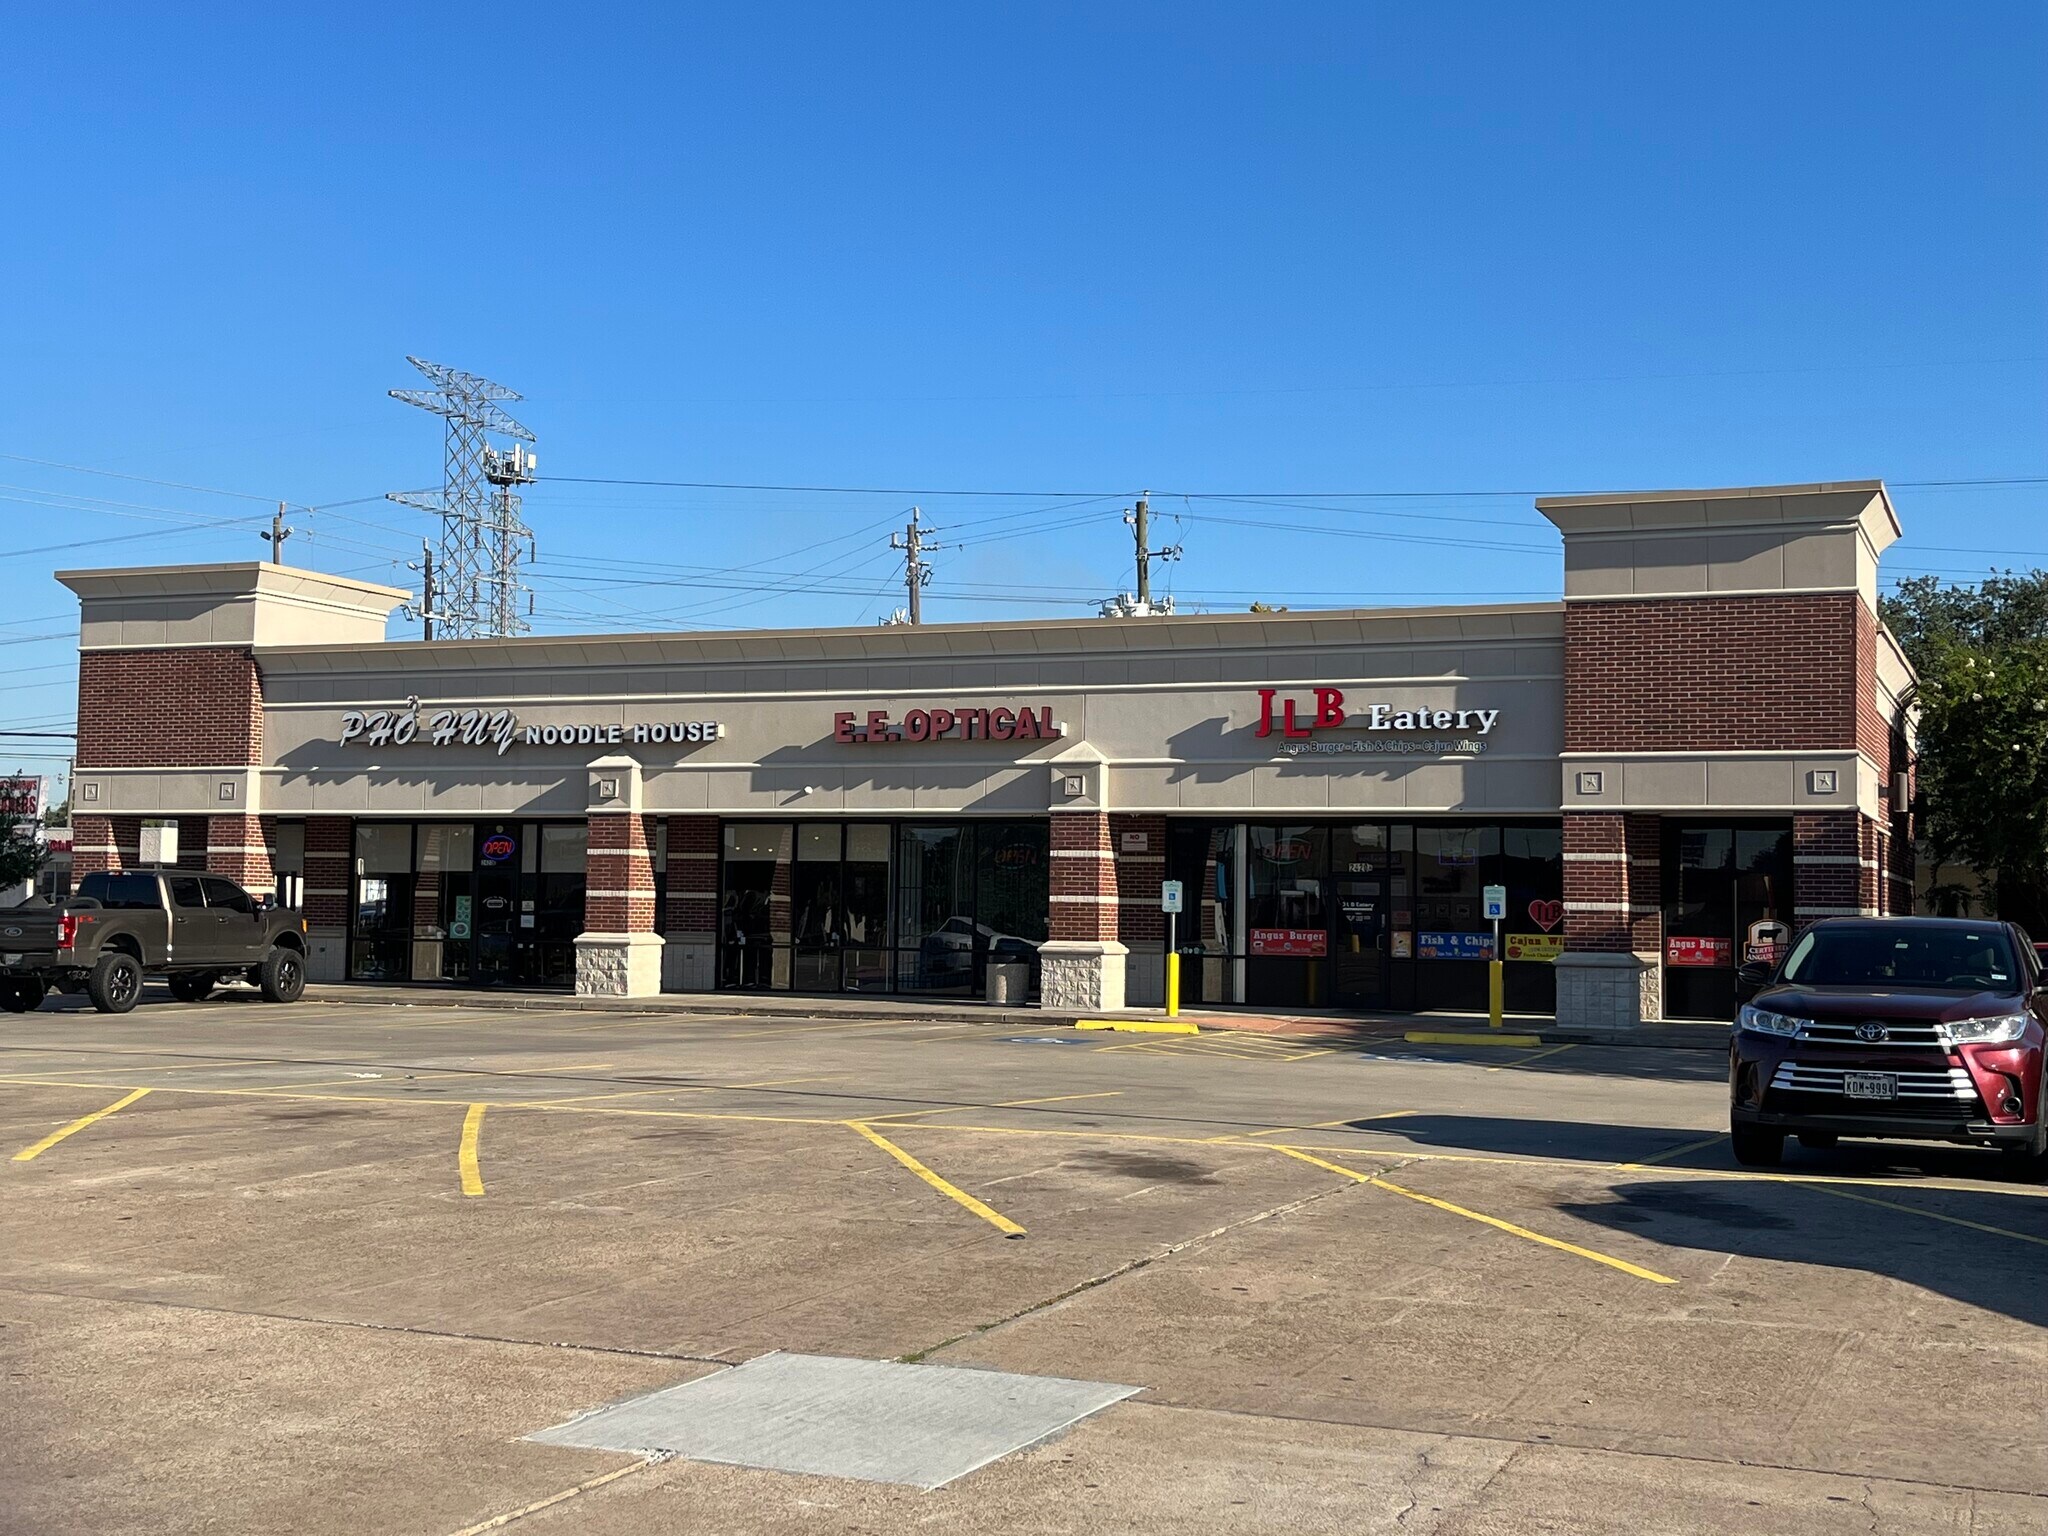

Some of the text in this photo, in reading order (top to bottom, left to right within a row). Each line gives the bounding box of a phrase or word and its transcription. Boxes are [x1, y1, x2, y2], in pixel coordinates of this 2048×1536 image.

[903, 706, 1062, 742] OPTICAL
[1368, 703, 1499, 735] Eatery
[429, 708, 519, 756] HUY
[525, 725, 623, 746] NOODLE
[633, 720, 718, 744] HOUSE
[1277, 741, 1309, 756] Angus
[1311, 741, 1344, 754] Burger
[1352, 740, 1374, 752] Fish
[1375, 741, 1384, 752] &
[1384, 740, 1414, 754] Chips
[1422, 740, 1452, 754] Cajun
[1453, 739, 1487, 753] Wings
[484, 841, 513, 855] OPEN
[1253, 931, 1324, 942] Angus Burger
[1420, 934, 1445, 945] Fish
[1449, 935, 1459, 945] &
[1510, 936, 1541, 946] Cajun
[1669, 939, 1729, 951] Angus Burger
